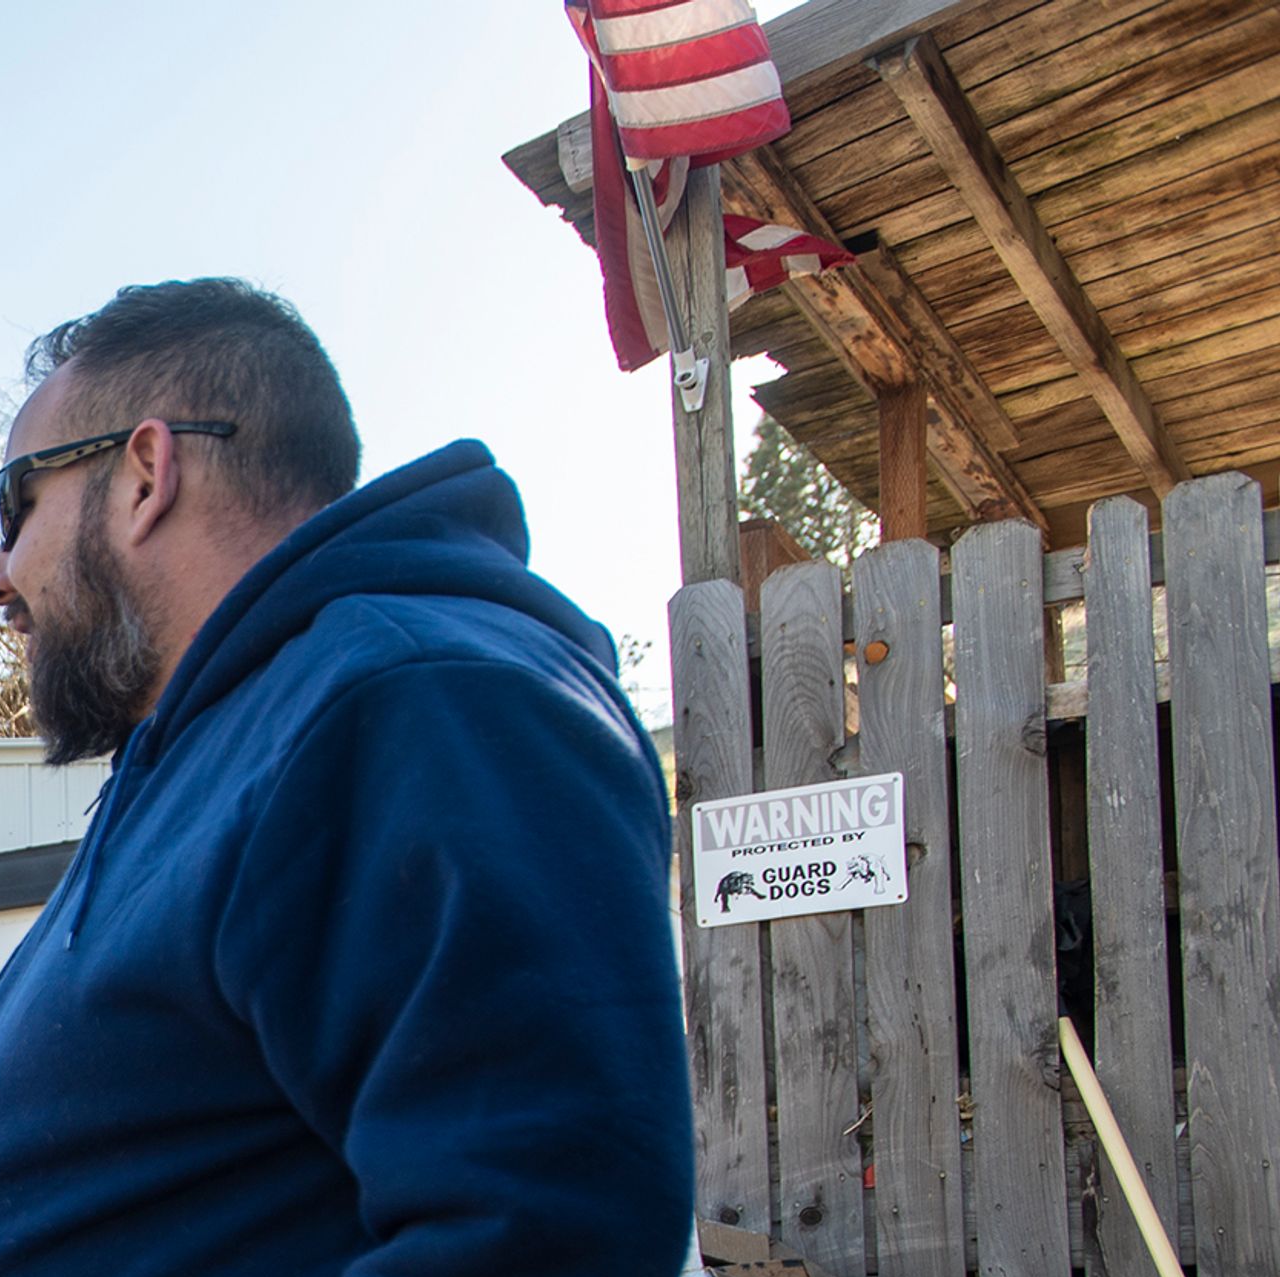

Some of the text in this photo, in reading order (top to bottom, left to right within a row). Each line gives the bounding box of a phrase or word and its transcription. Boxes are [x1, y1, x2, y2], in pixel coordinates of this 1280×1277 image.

[705, 784, 889, 849] WARNING
[731, 831, 866, 858] PROTECTED BY
[762, 861, 837, 884] GUARD
[769, 878, 831, 900] DOGS
